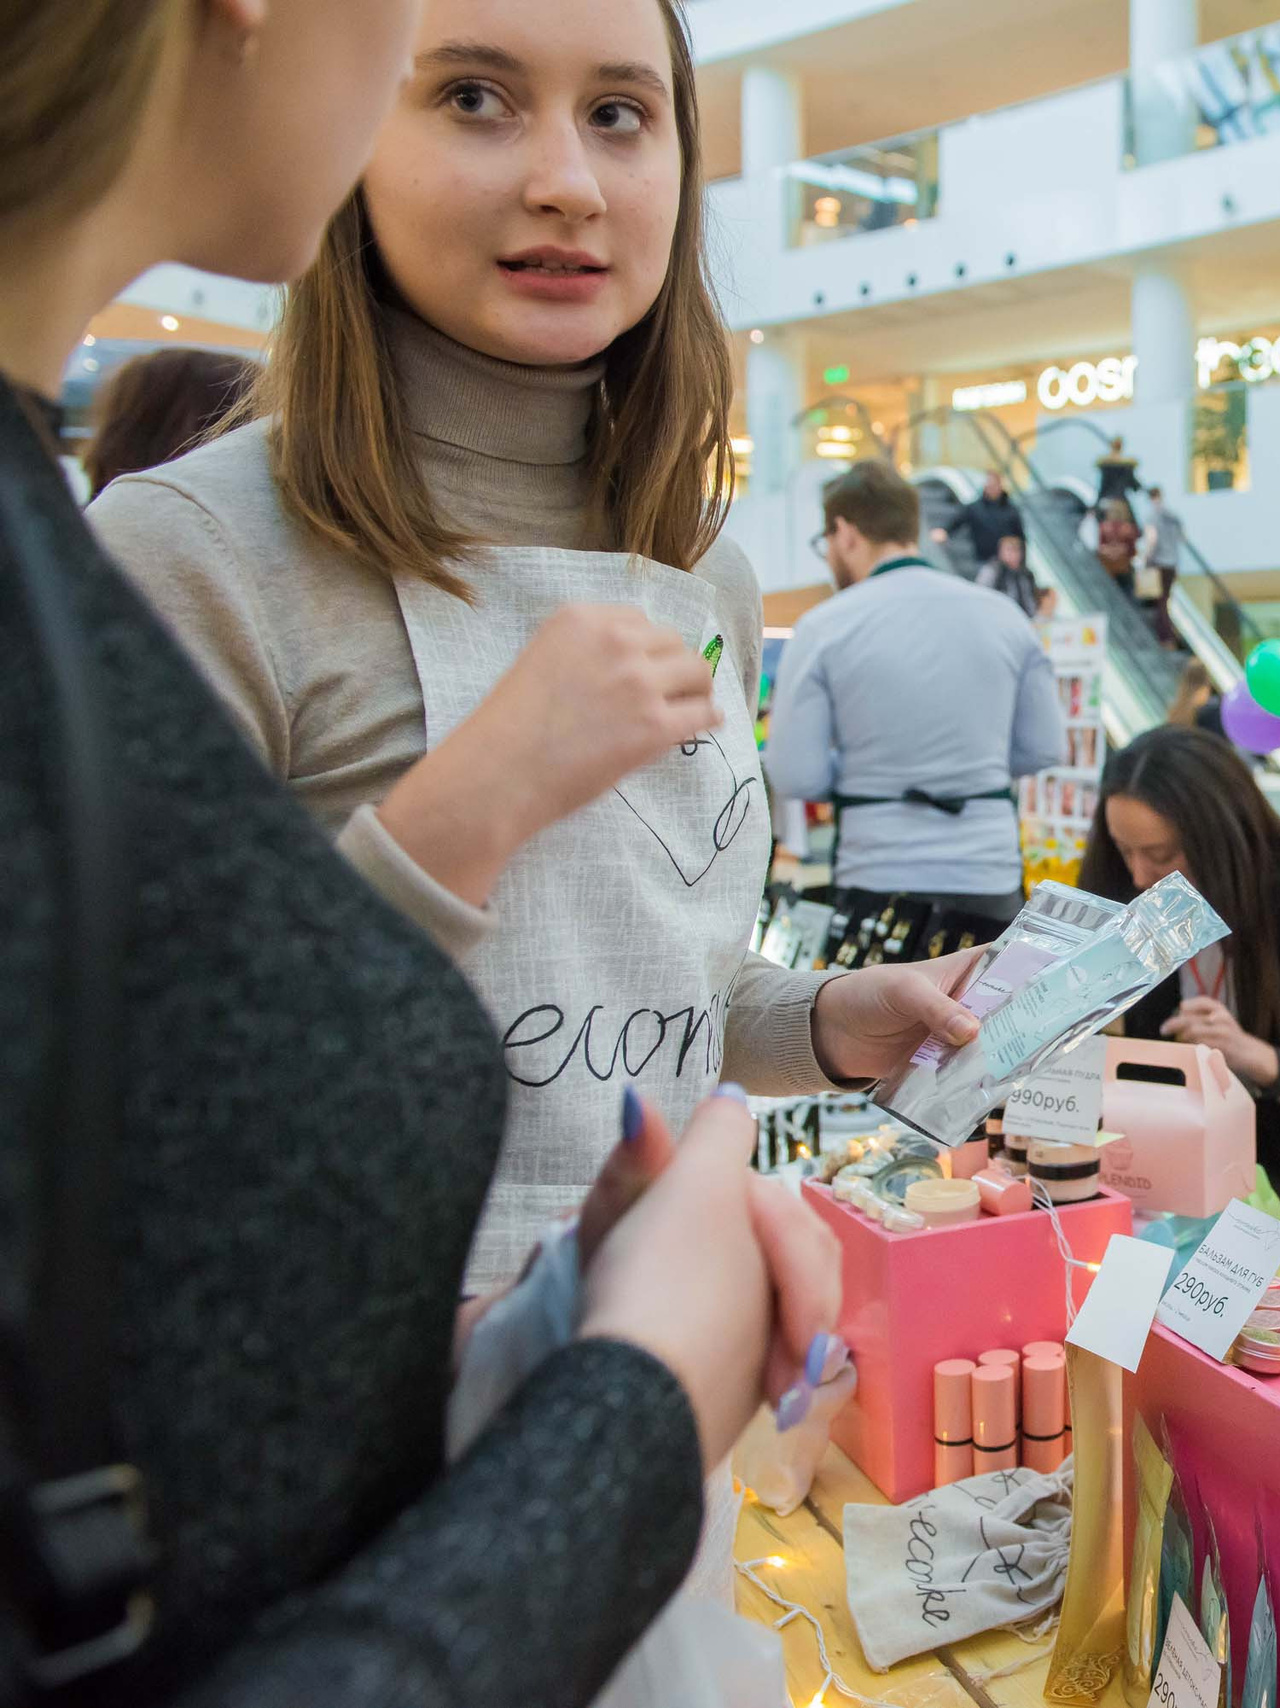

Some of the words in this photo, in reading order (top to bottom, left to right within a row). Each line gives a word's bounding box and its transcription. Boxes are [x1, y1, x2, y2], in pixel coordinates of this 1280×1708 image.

[1198, 1244, 1233, 1270] БАЛЬЗАМ
[1230, 1263, 1250, 1278] ДЛЯ
[1247, 1272, 1265, 1288] ГУБ
[1174, 1272, 1229, 1318] 290руб.
